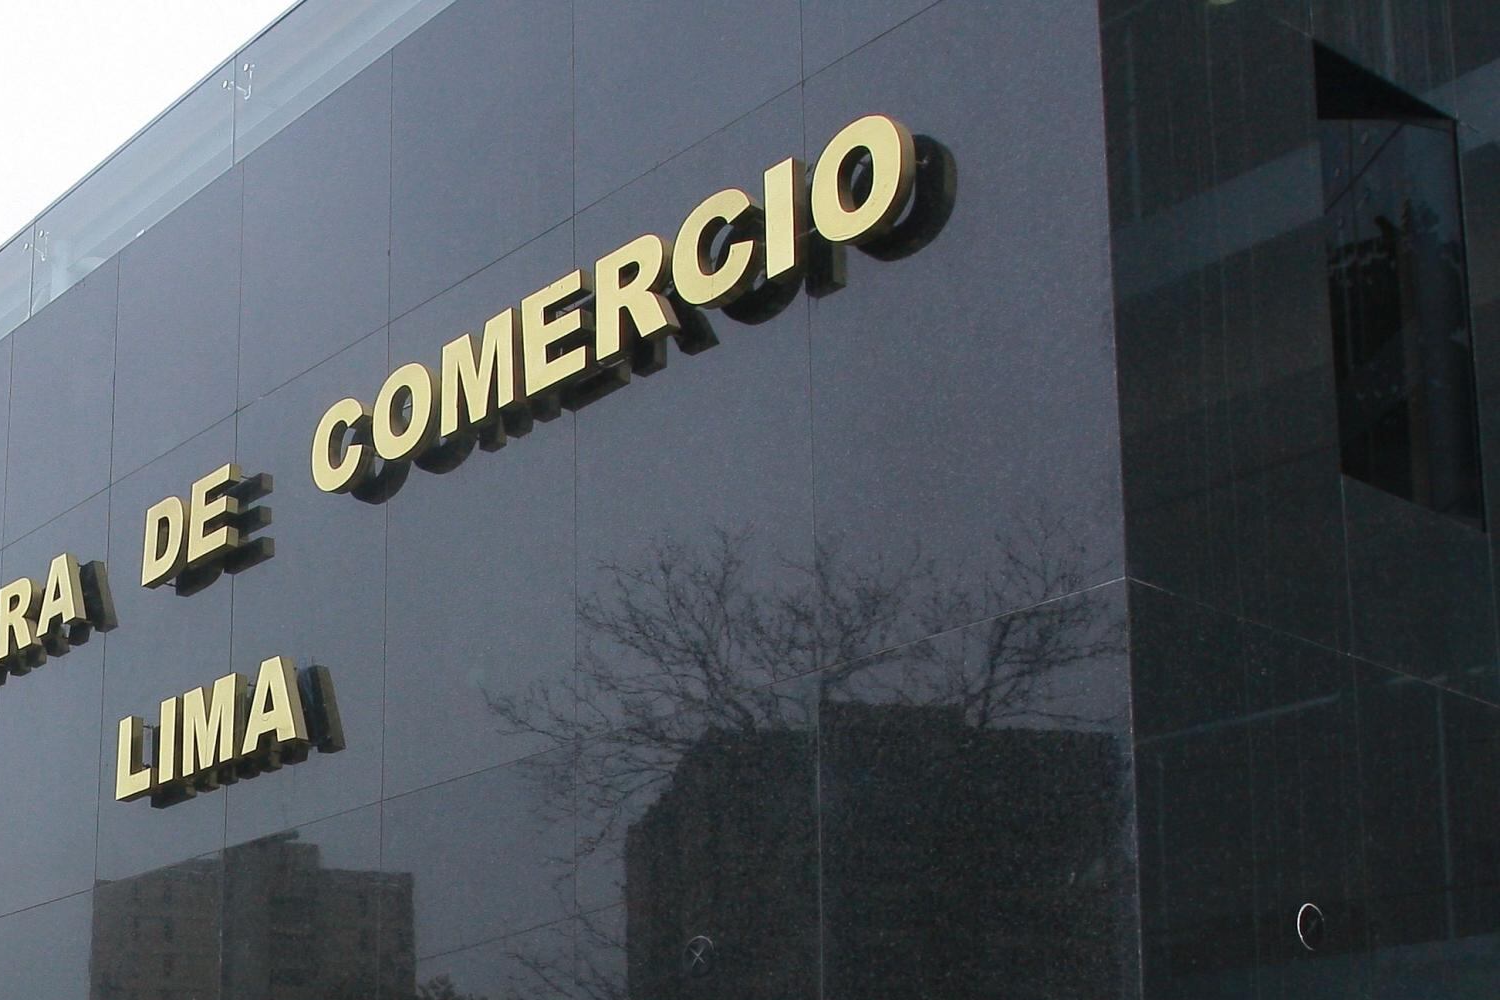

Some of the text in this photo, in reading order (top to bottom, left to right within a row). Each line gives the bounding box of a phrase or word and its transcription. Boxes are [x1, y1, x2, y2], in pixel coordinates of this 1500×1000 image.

[141, 463, 241, 588] DE
[311, 114, 914, 493] COMERCIO
[115, 655, 307, 800] LIMA
